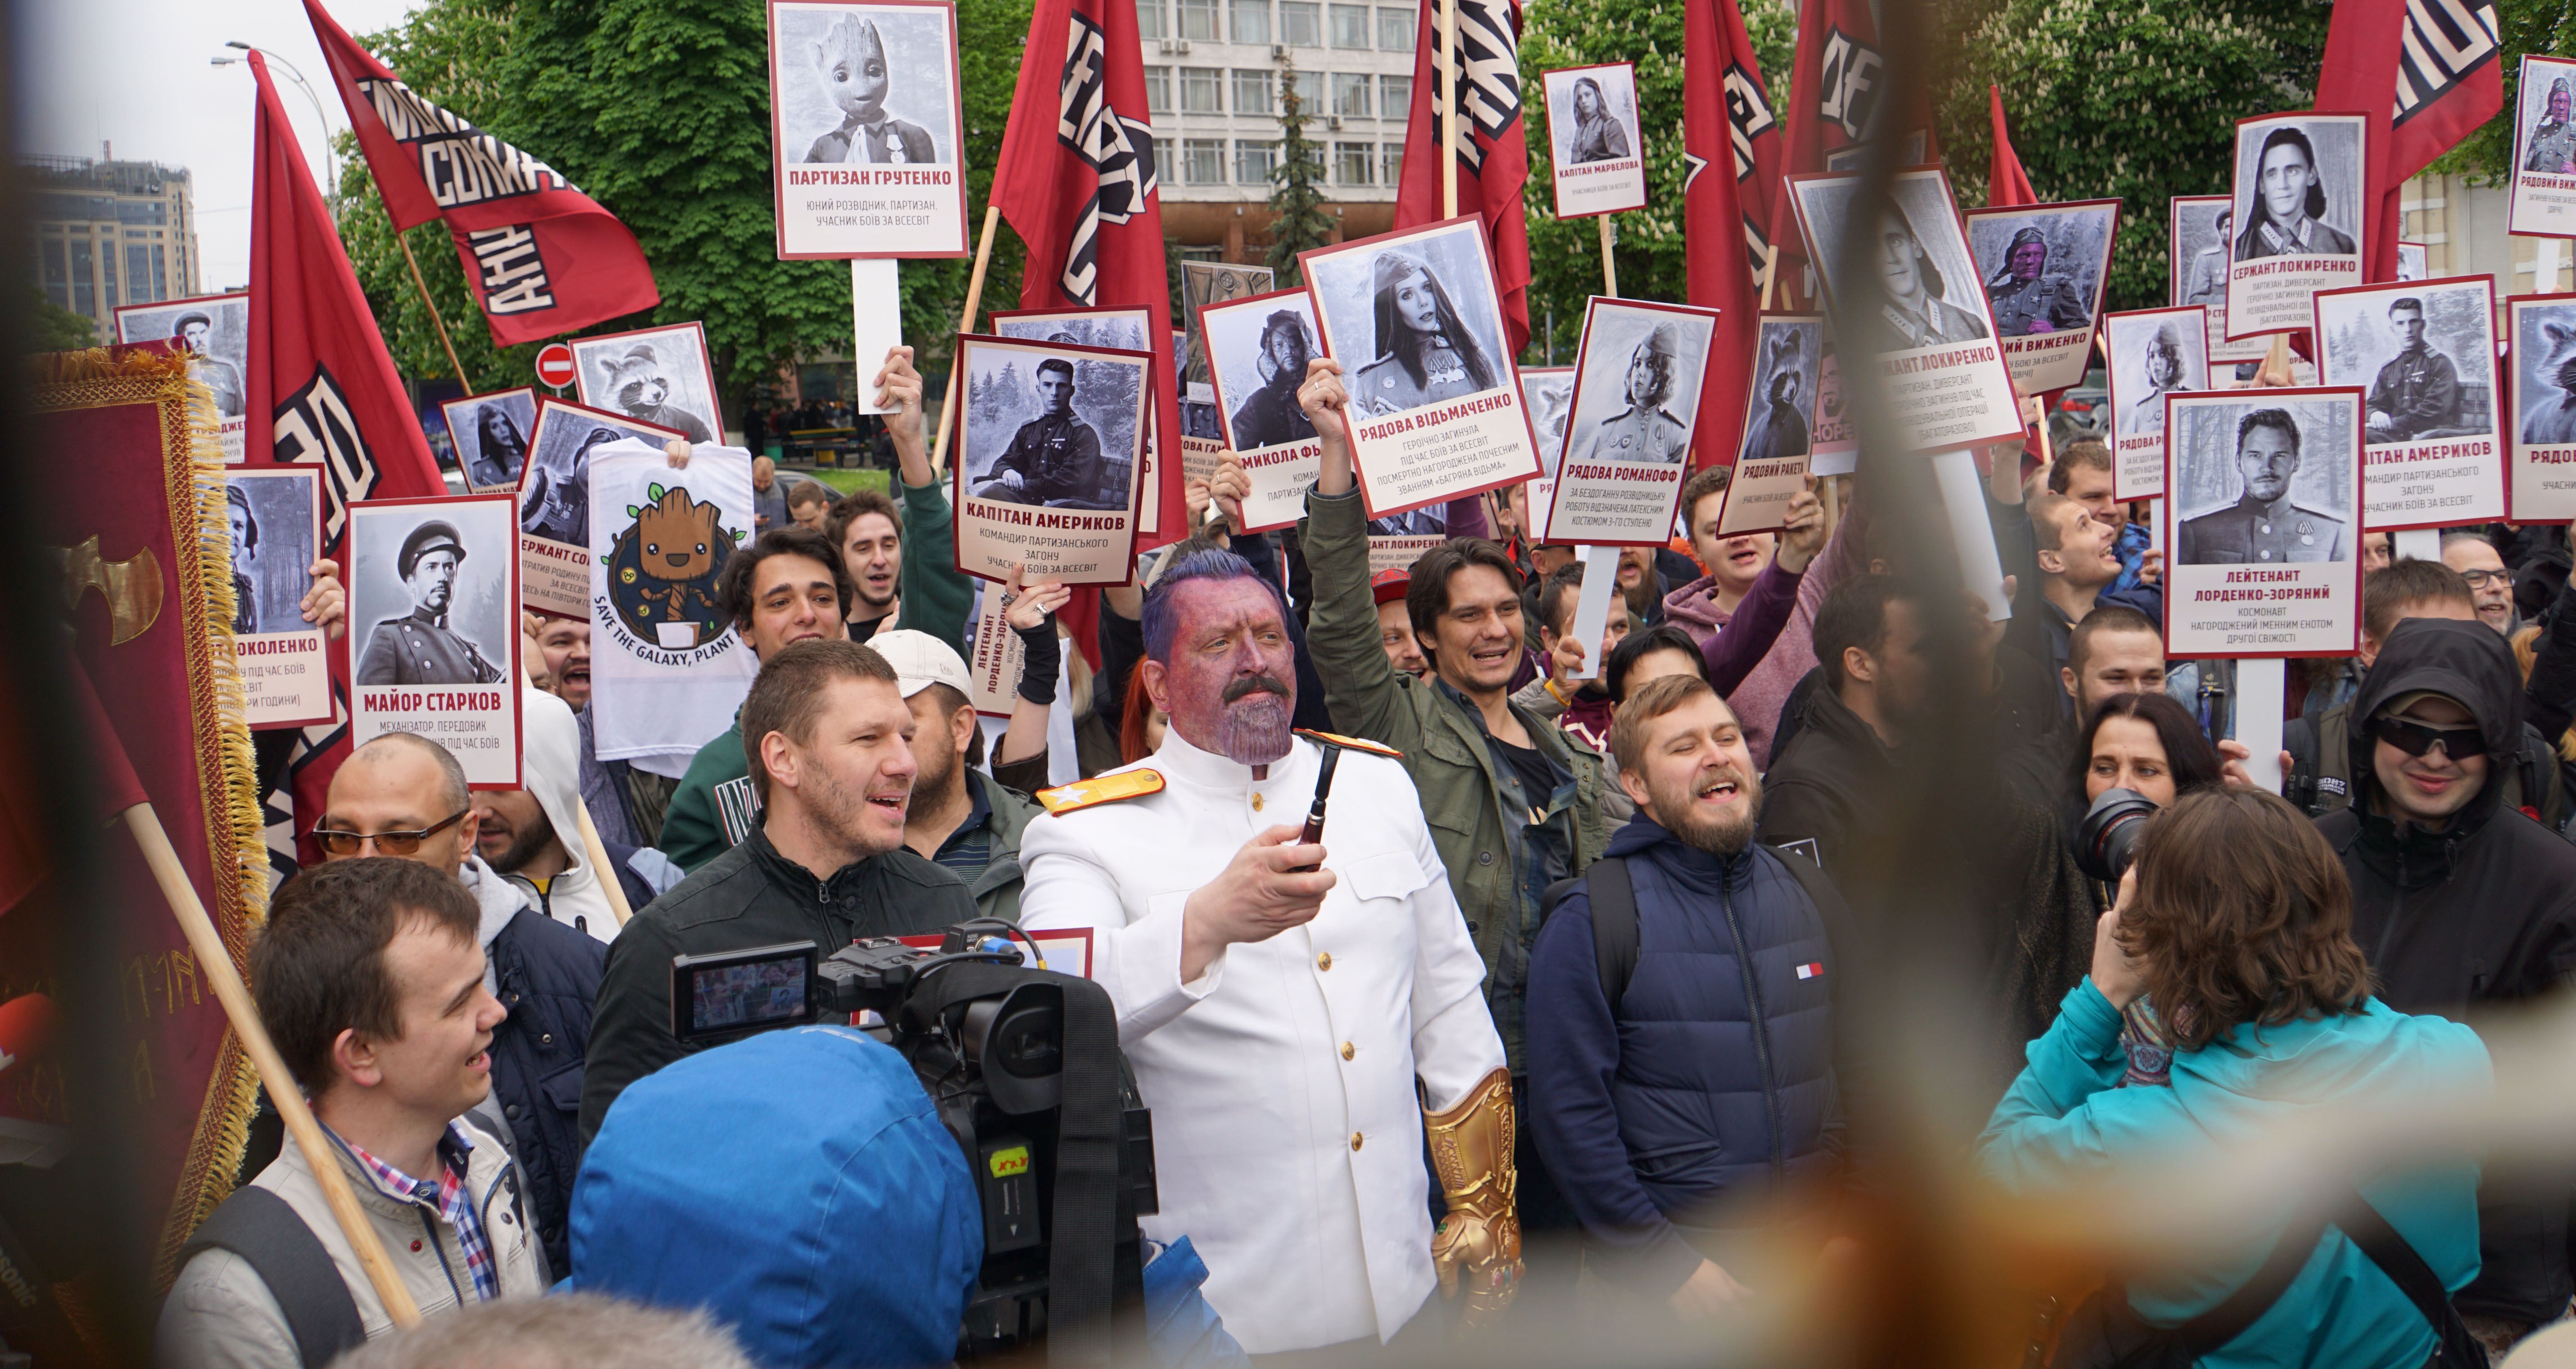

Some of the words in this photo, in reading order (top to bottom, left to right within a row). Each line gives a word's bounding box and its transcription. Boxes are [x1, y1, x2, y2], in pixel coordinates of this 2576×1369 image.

[1559, 167, 1592, 178] КАПІТАН
[1595, 161, 1639, 174] МАРВЕЛОВА
[789, 171, 870, 185] ПАРТИЗАН
[875, 171, 952, 186] ГРУТЕНКО
[2521, 176, 2558, 189] РЯДОВИЙ
[2558, 179, 2576, 190] ВИЖ
[807, 199, 834, 211] ЮНИЙ
[836, 200, 889, 211] РОЗВІДНИК,
[890, 201, 938, 211] ПАРТИЗАН,
[816, 215, 857, 226] УЧАСНИК
[859, 214, 880, 226] БОЇВ
[883, 216, 893, 225] ЗА
[895, 215, 930, 226] ВСЕСВІТ
[2234, 263, 2277, 280] СЕРЖАНТ
[2278, 260, 2356, 273] ЛОКИРЕНКО
[2285, 278, 2326, 287] ДИВЕРСАНТ
[2247, 293, 2273, 304] ГЕРОЇЧНО
[2274, 290, 2305, 300] ЗАГИНУВ
[2260, 313, 2311, 326] (БАГАТОРАЗОВО
[2026, 332, 2086, 352] ВИЖЕНКО
[1921, 346, 1995, 372] ЛОКИРЕНКО
[2009, 360, 2014, 368] У
[2015, 358, 2031, 368] БОЮ
[2032, 357, 2041, 367] ЗА
[2042, 352, 2069, 365] ВСЕСВІТ
[1933, 374, 1973, 390] ДИВЕРСАНТ
[1971, 388, 1986, 399] ЧАС
[1359, 417, 1414, 442] РЯДОВА
[1415, 393, 1512, 429] ВІДЬМАЧЕНКО
[1402, 434, 1440, 451] ГЕРОЇЧНО
[1440, 424, 1480, 442] ЗАГИНУЛА
[2120, 437, 2154, 451] РЯДОВА
[1400, 455, 1415, 466] ПІД
[1415, 452, 1429, 463] ЧАС
[1429, 447, 1448, 460] БОЇВ
[1448, 444, 1459, 454] ЗА
[1459, 435, 1489, 451] ВСЕСВІТ
[2408, 441, 2493, 462] АМЕРИКОВ
[1242, 449, 1299, 470] МИКОЛА
[1377, 468, 1422, 486] ПОСМЕРТНО
[1422, 453, 1478, 474] НАГОРОДЖЕНА
[1478, 442, 1520, 460] ПОЧЕСНИМ
[1293, 470, 1320, 483] КОМАН
[1567, 464, 1611, 480] РЯДОВА
[1614, 467, 1678, 483] РОМАНОФФ
[1743, 461, 1779, 479] РЯДОВИЙ
[1780, 461, 1804, 476] РАКЕТА
[2124, 467, 2144, 476] РОБОТУ
[2365, 473, 2402, 485] МАНДИР
[2404, 466, 2479, 482] ПАРТИЗАНСЬКОГО
[1397, 479, 1434, 495] ЗВАННЯМ
[1435, 468, 1473, 485] «БАГРЯНА
[1474, 462, 1506, 476] ВІДЬМА»
[2543, 481, 2576, 490] УЧАСНИ
[1267, 488, 1306, 502] ПАРТИЗАН
[1569, 488, 1578, 498] ЗА
[1579, 488, 1620, 499] БЕЗДОГАННУ
[1620, 490, 1665, 501] РОЗВІДНИЦЬКУ
[2401, 484, 2434, 496] ЗАГОНУ
[1565, 502, 1590, 512] РОБОТУ
[1590, 503, 1628, 513] ВІДЗНАЧЕНА
[1628, 504, 1664, 514] ЛАТЕКСНИМ
[2406, 497, 2426, 510] БОЇВ
[2428, 498, 2438, 508] ЗА
[2440, 495, 2473, 507] ВСЕСВІТ
[966, 502, 1032, 526] КАПІТАН
[1035, 513, 1125, 530] АМЕРИКОВ
[1572, 516, 1608, 526] КОСТЮМОМ
[1623, 518, 1652, 528] СТУПЕНЮ
[980, 527, 1027, 544] КОМАНДИР
[1029, 536, 1108, 548] ПАРТИЗАНСЬКОГО
[522, 539, 571, 561] ЕРЖАНТ
[1025, 549, 1059, 561] ЗАГОНУ
[987, 555, 1025, 572] УЧАСНК
[1027, 562, 1048, 574] БОЇВ
[1050, 563, 1060, 574] ЗА
[1062, 563, 1098, 573] ВСЕСВІТ
[551, 567, 581, 582] РОДИНУ
[2226, 568, 2301, 583] ЛЕЙТЕНАНТ
[549, 579, 559, 588] ЗА
[560, 581, 589, 595] ВСЕСВІТ
[2195, 584, 2330, 603] ЛОРДЕНКО-ЗОРЯНИЙ
[540, 589, 550, 598] НА
[551, 591, 581, 605] ПІВТОРИ
[2238, 607, 2287, 617] КОСМОНАВТ
[594, 596, 614, 630] SAVE
[612, 627, 636, 652] THE
[636, 646, 692, 667] GALAXY,
[695, 632, 735, 663] PLANT
[2191, 619, 2258, 631] НАГОРОДЖЕНИЙ
[2259, 620, 2298, 630] ІМЕННИМ
[2300, 619, 2333, 629] ЄНОТОМ
[977, 613, 995, 670] ЛЕЙТЕНАНТ
[2227, 633, 2257, 644] ДРУГОЇ
[2258, 633, 2296, 643] СВІЖОСТІ
[237, 638, 318, 656] ОКОЛЕНКО
[249, 666, 264, 677] ПІД
[266, 665, 282, 675] ЧАС
[285, 664, 305, 675] БОЇВ
[261, 694, 300, 707] ГОДИНИ)
[364, 689, 422, 712] МАЙОР
[426, 692, 501, 712] СТАРКОВ
[438, 721, 486, 733] ПЕРЕДОВИК
[448, 738, 461, 749] ПІД
[463, 738, 478, 748] ЧАС
[480, 735, 500, 748] БОЇВ
